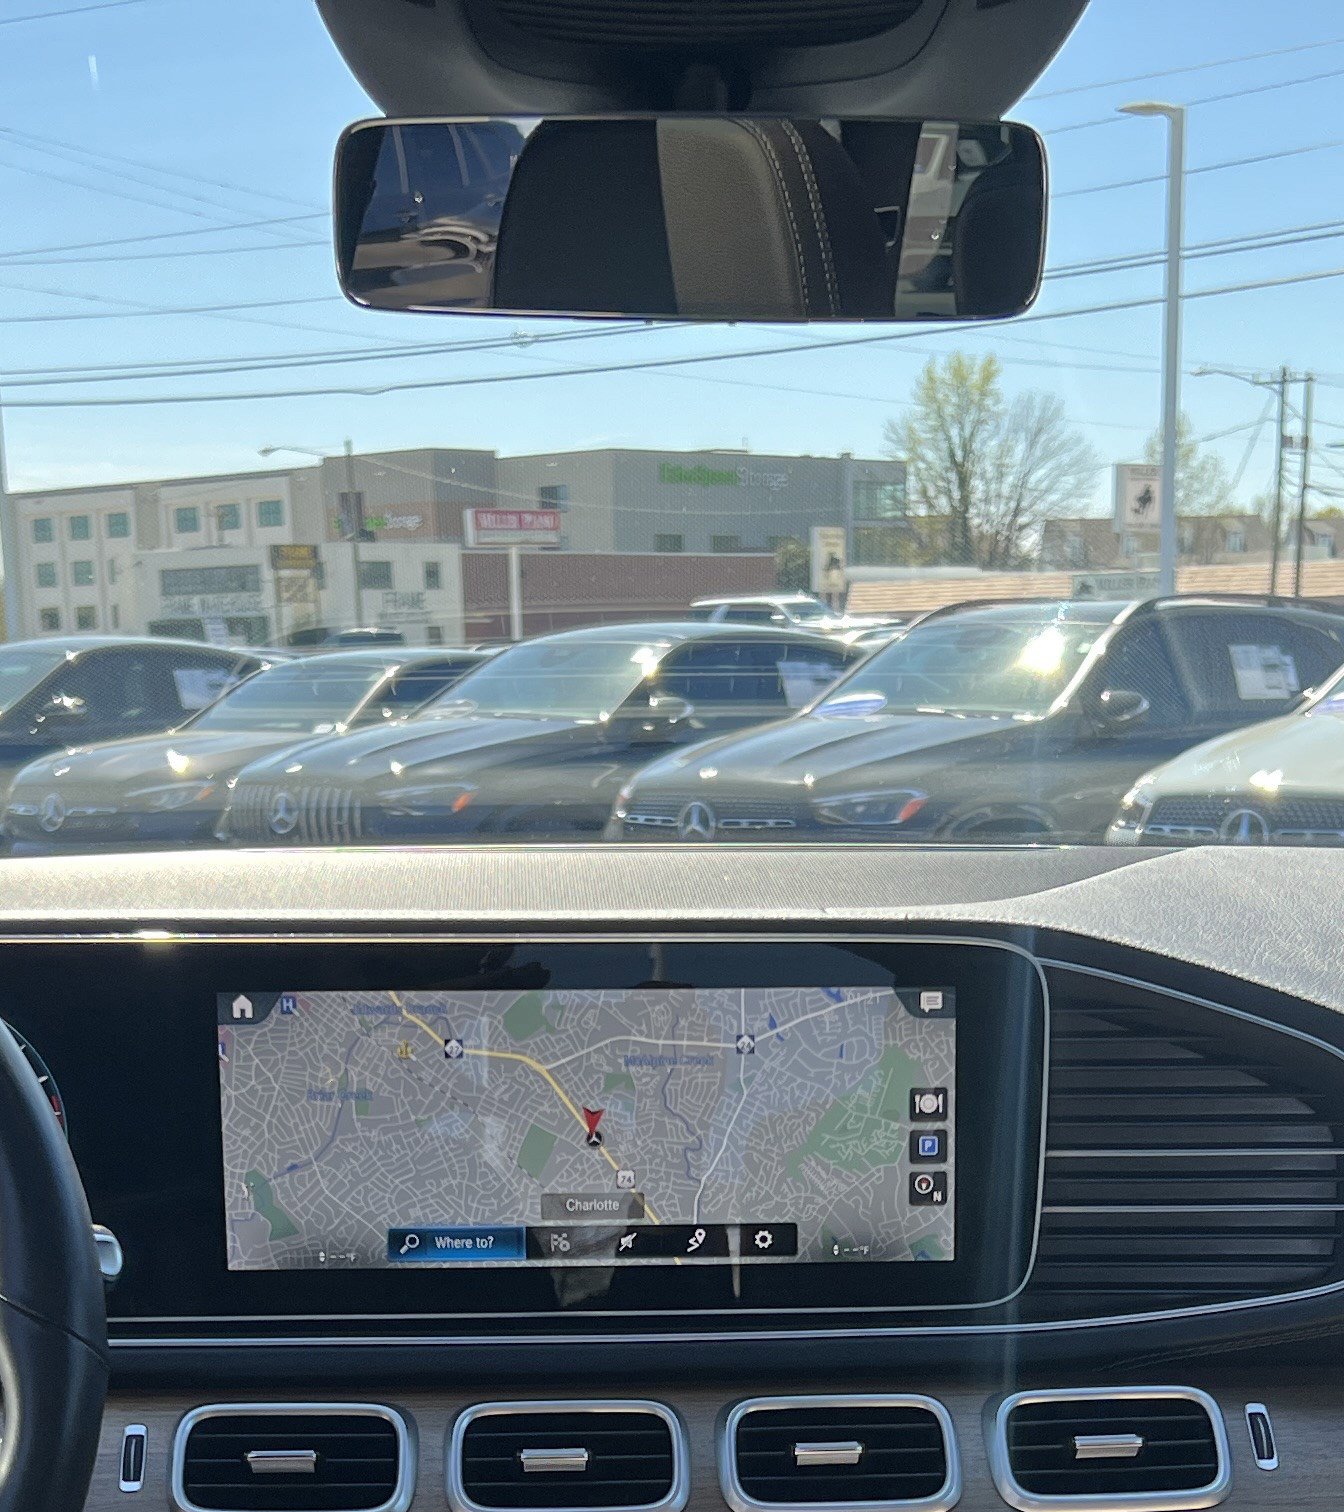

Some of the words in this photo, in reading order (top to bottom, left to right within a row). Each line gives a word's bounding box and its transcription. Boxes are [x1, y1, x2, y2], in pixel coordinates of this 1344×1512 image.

[932, 1190, 942, 1202] N
[565, 1198, 620, 1212] Charlotte
[434, 1236, 473, 1250] Where
[475, 1235, 494, 1250] to?
